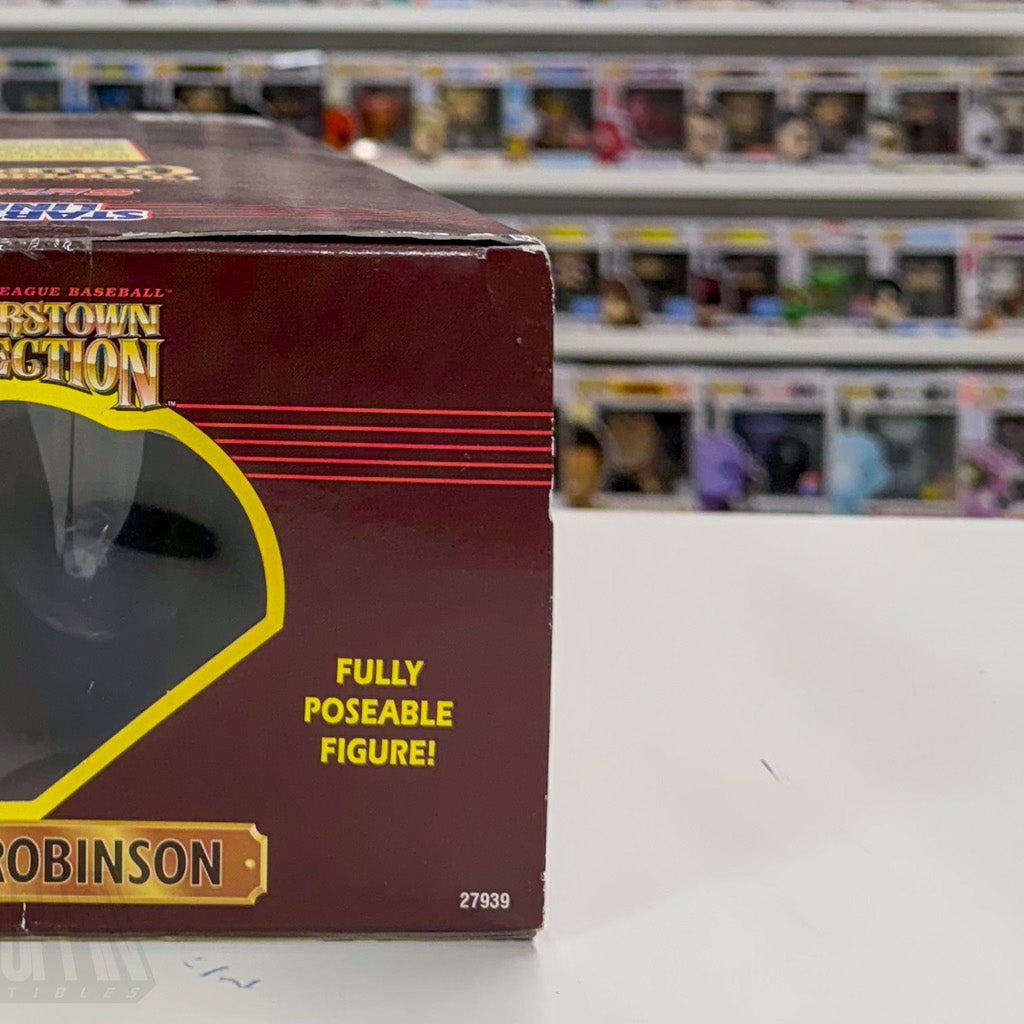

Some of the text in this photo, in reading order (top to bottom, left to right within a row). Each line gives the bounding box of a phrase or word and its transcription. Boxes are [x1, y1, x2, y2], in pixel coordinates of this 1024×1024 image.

[336, 657, 425, 687] FULLY
[304, 696, 455, 727] POSEABLE
[320, 736, 437, 766] FIGURE!
[459, 891, 511, 909] 27939
